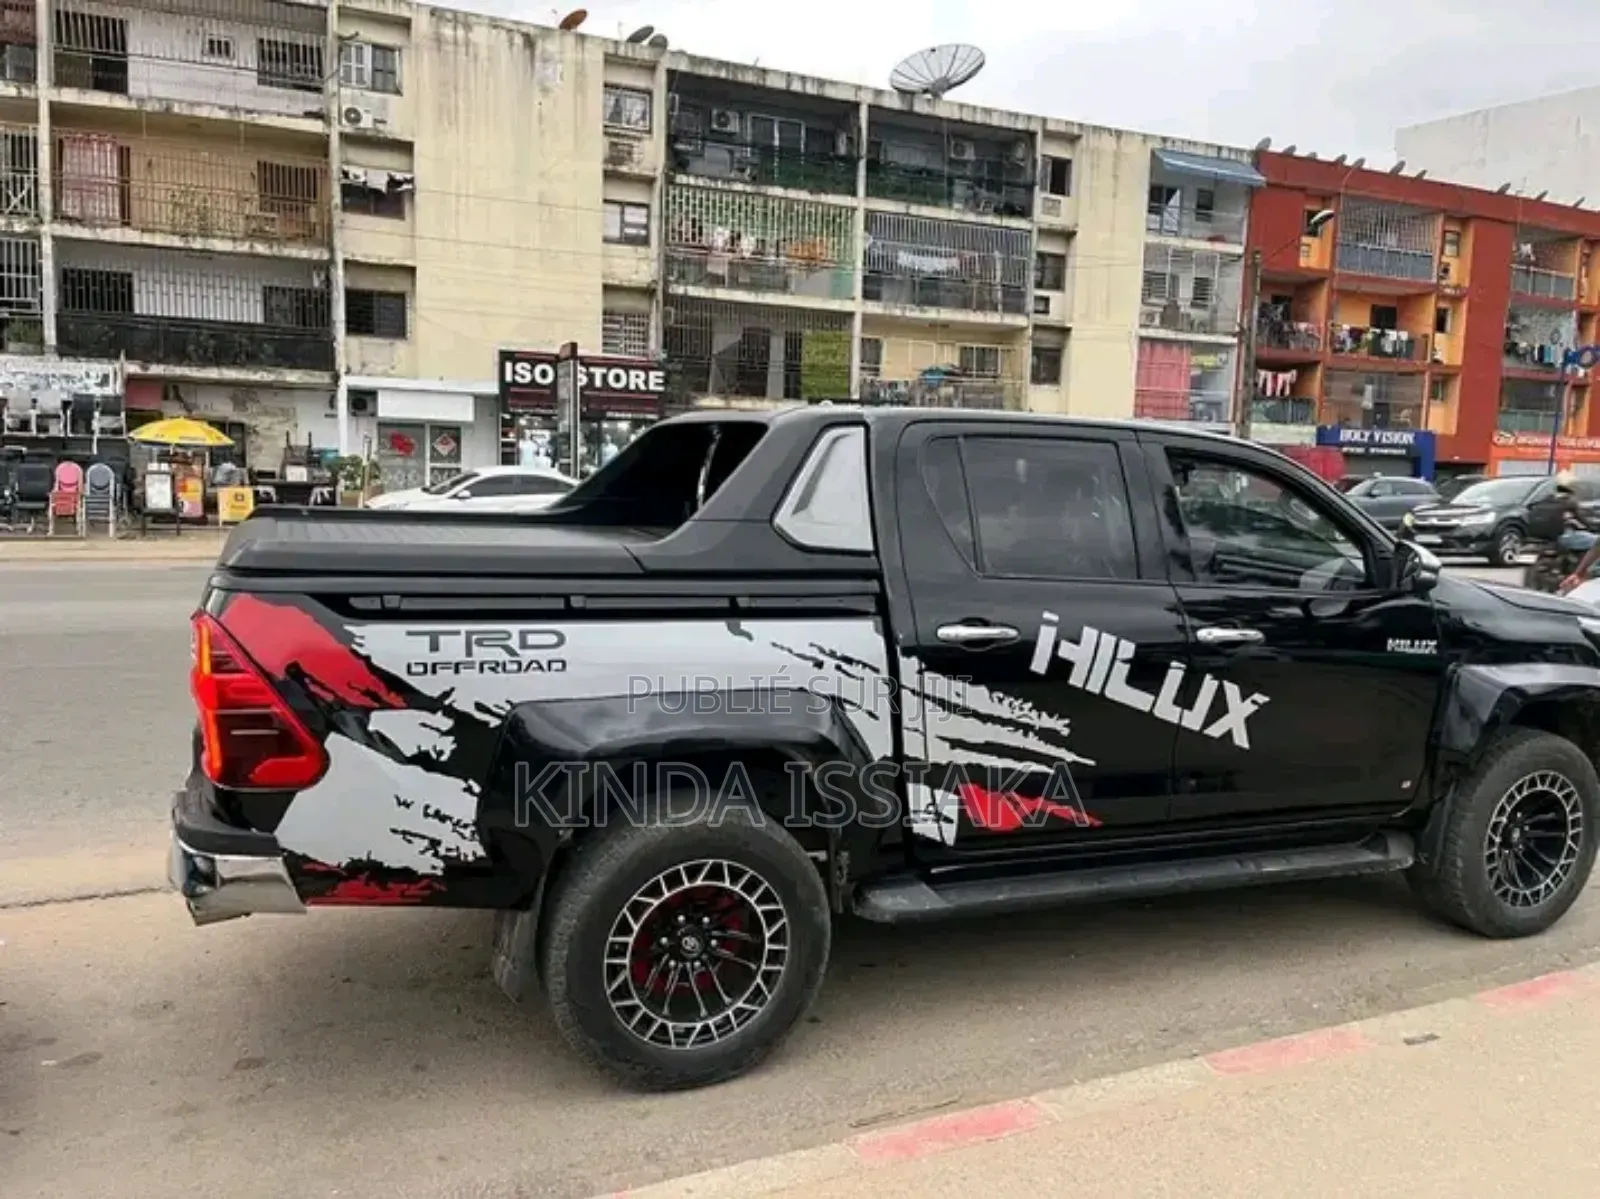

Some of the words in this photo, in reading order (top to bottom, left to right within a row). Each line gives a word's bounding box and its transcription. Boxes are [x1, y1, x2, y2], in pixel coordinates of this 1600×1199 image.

[505, 361, 555, 385] ISO
[577, 365, 665, 392] STORE
[405, 629, 566, 657] TRD
[1387, 637, 1437, 654] HILUX
[1029, 610, 1270, 749] HILUX
